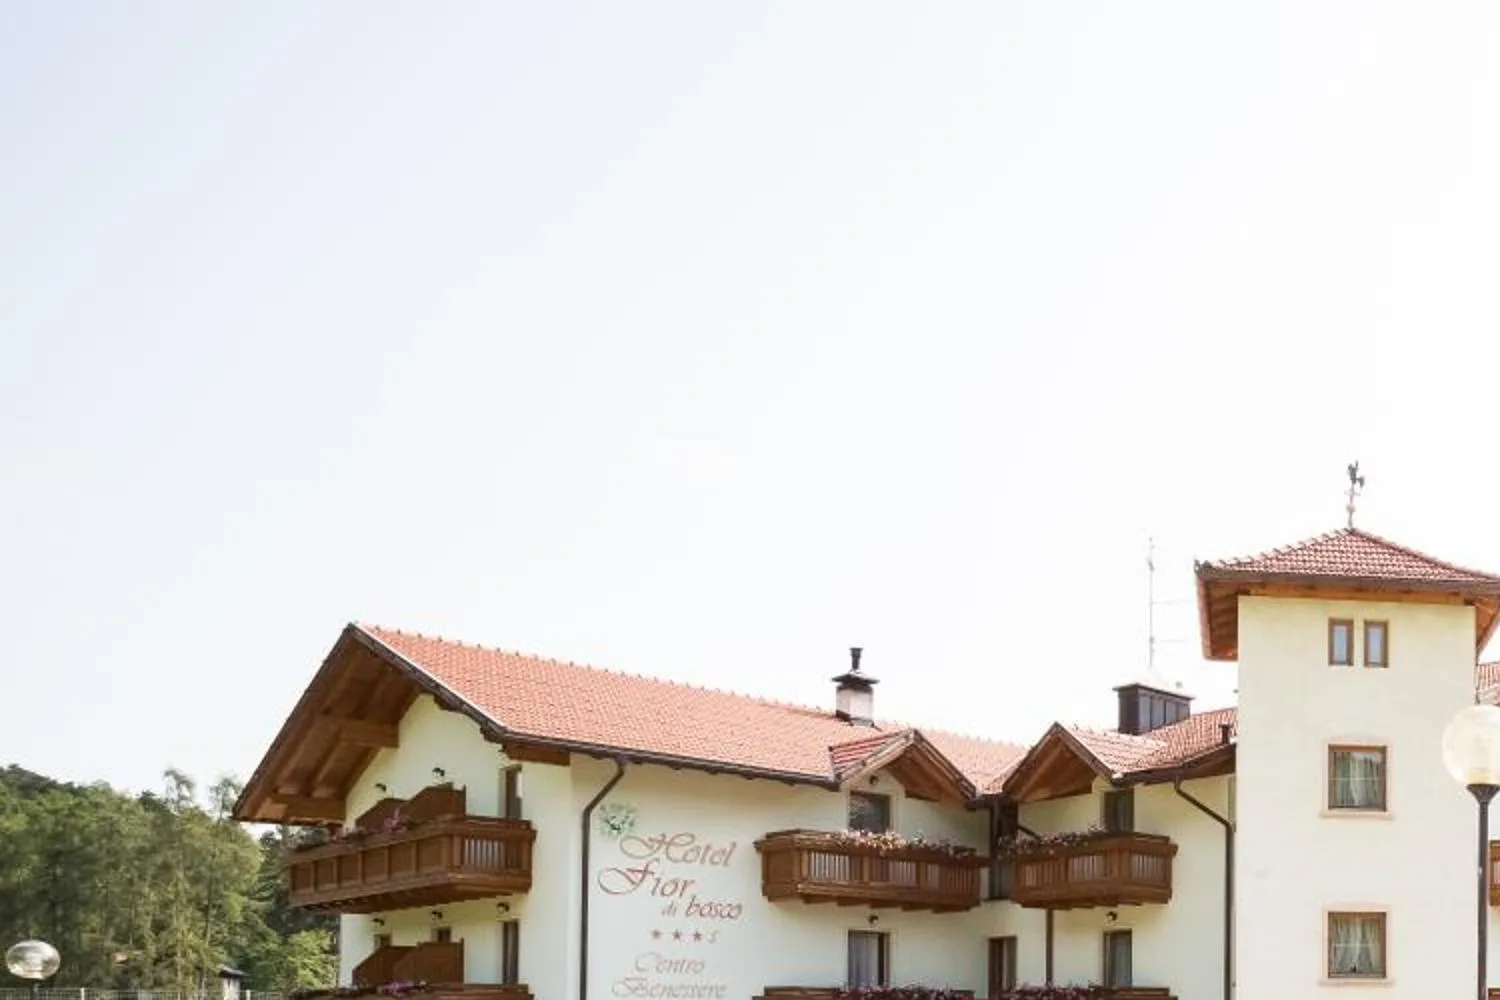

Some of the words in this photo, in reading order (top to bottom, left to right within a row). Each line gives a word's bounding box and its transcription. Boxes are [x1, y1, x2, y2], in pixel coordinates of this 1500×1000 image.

[619, 832, 737, 867] Hotel
[598, 858, 696, 897] Fior
[685, 894, 743, 919] bosco
[634, 951, 706, 974] Centro
[611, 977, 728, 1000] Benessere
